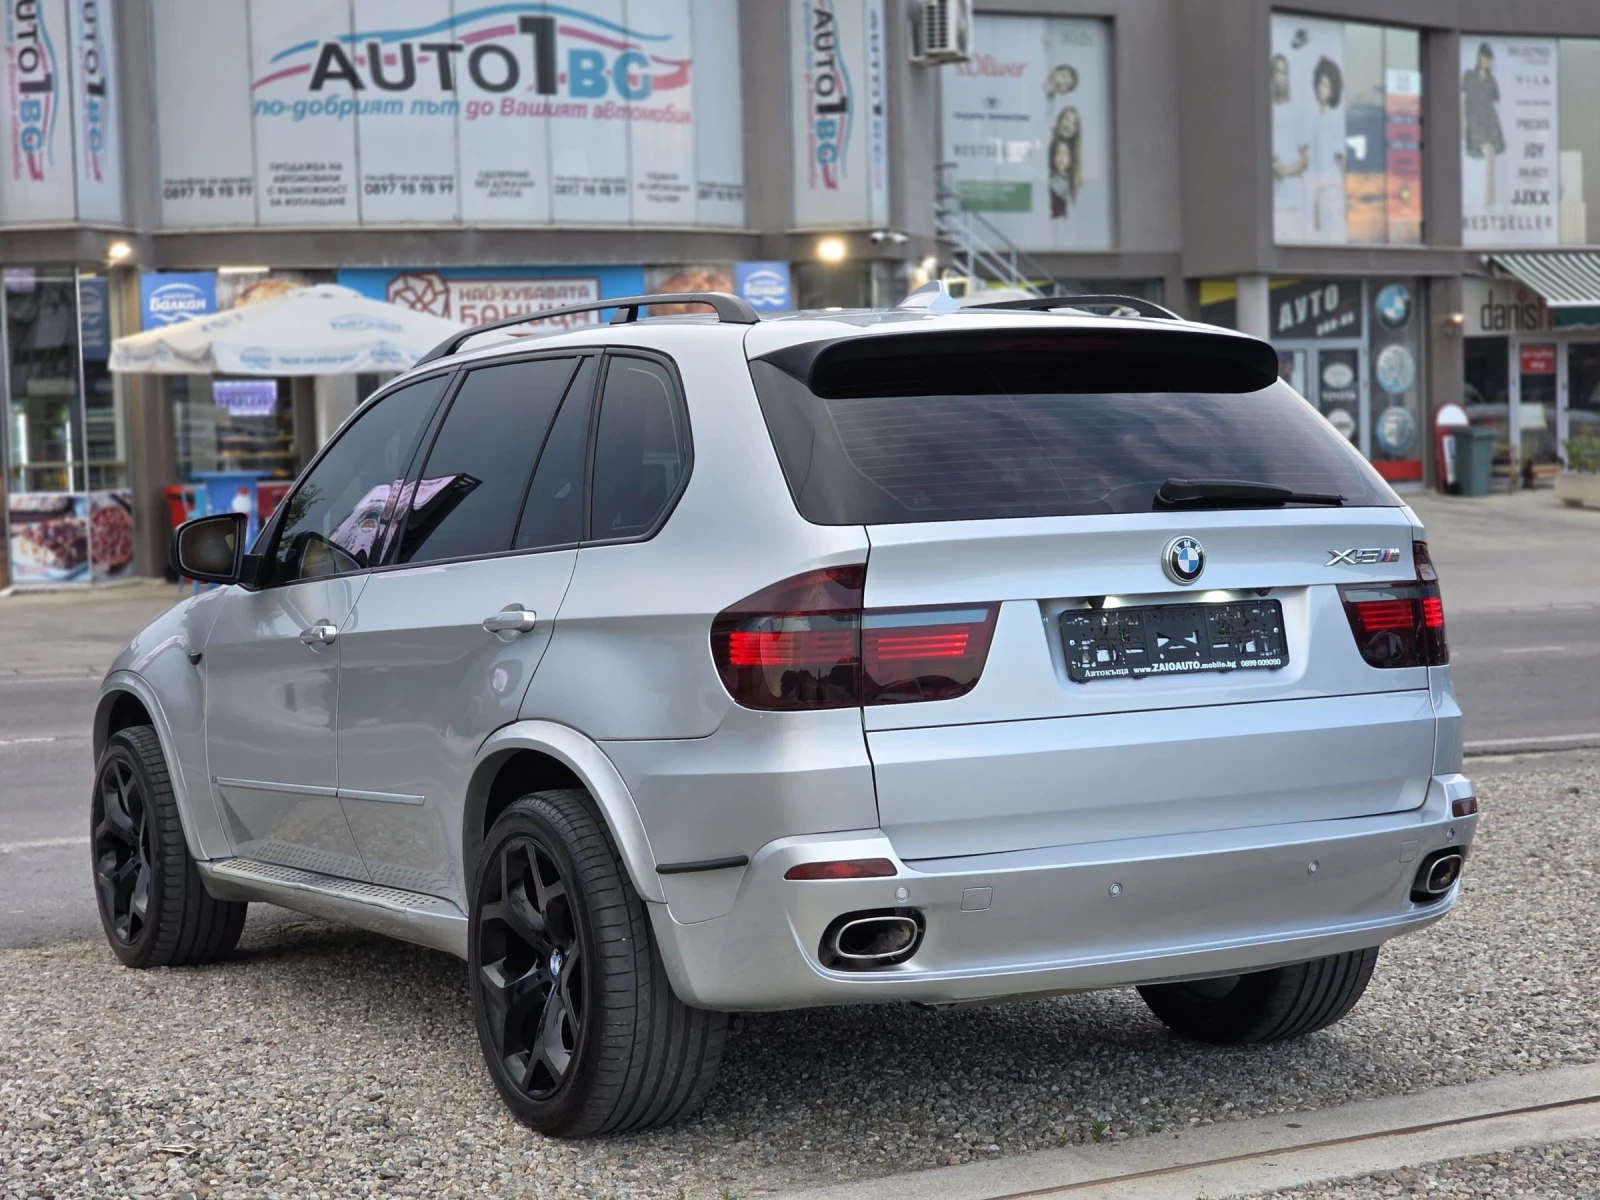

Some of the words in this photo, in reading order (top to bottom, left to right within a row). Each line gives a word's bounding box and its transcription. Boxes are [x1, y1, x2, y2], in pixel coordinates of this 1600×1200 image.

[255, 94, 403, 121] по-добрият
[411, 98, 460, 115] път
[466, 99, 494, 121] до
[501, 98, 588, 119] Вашият
[1085, 668, 1129, 677] Автокъща
